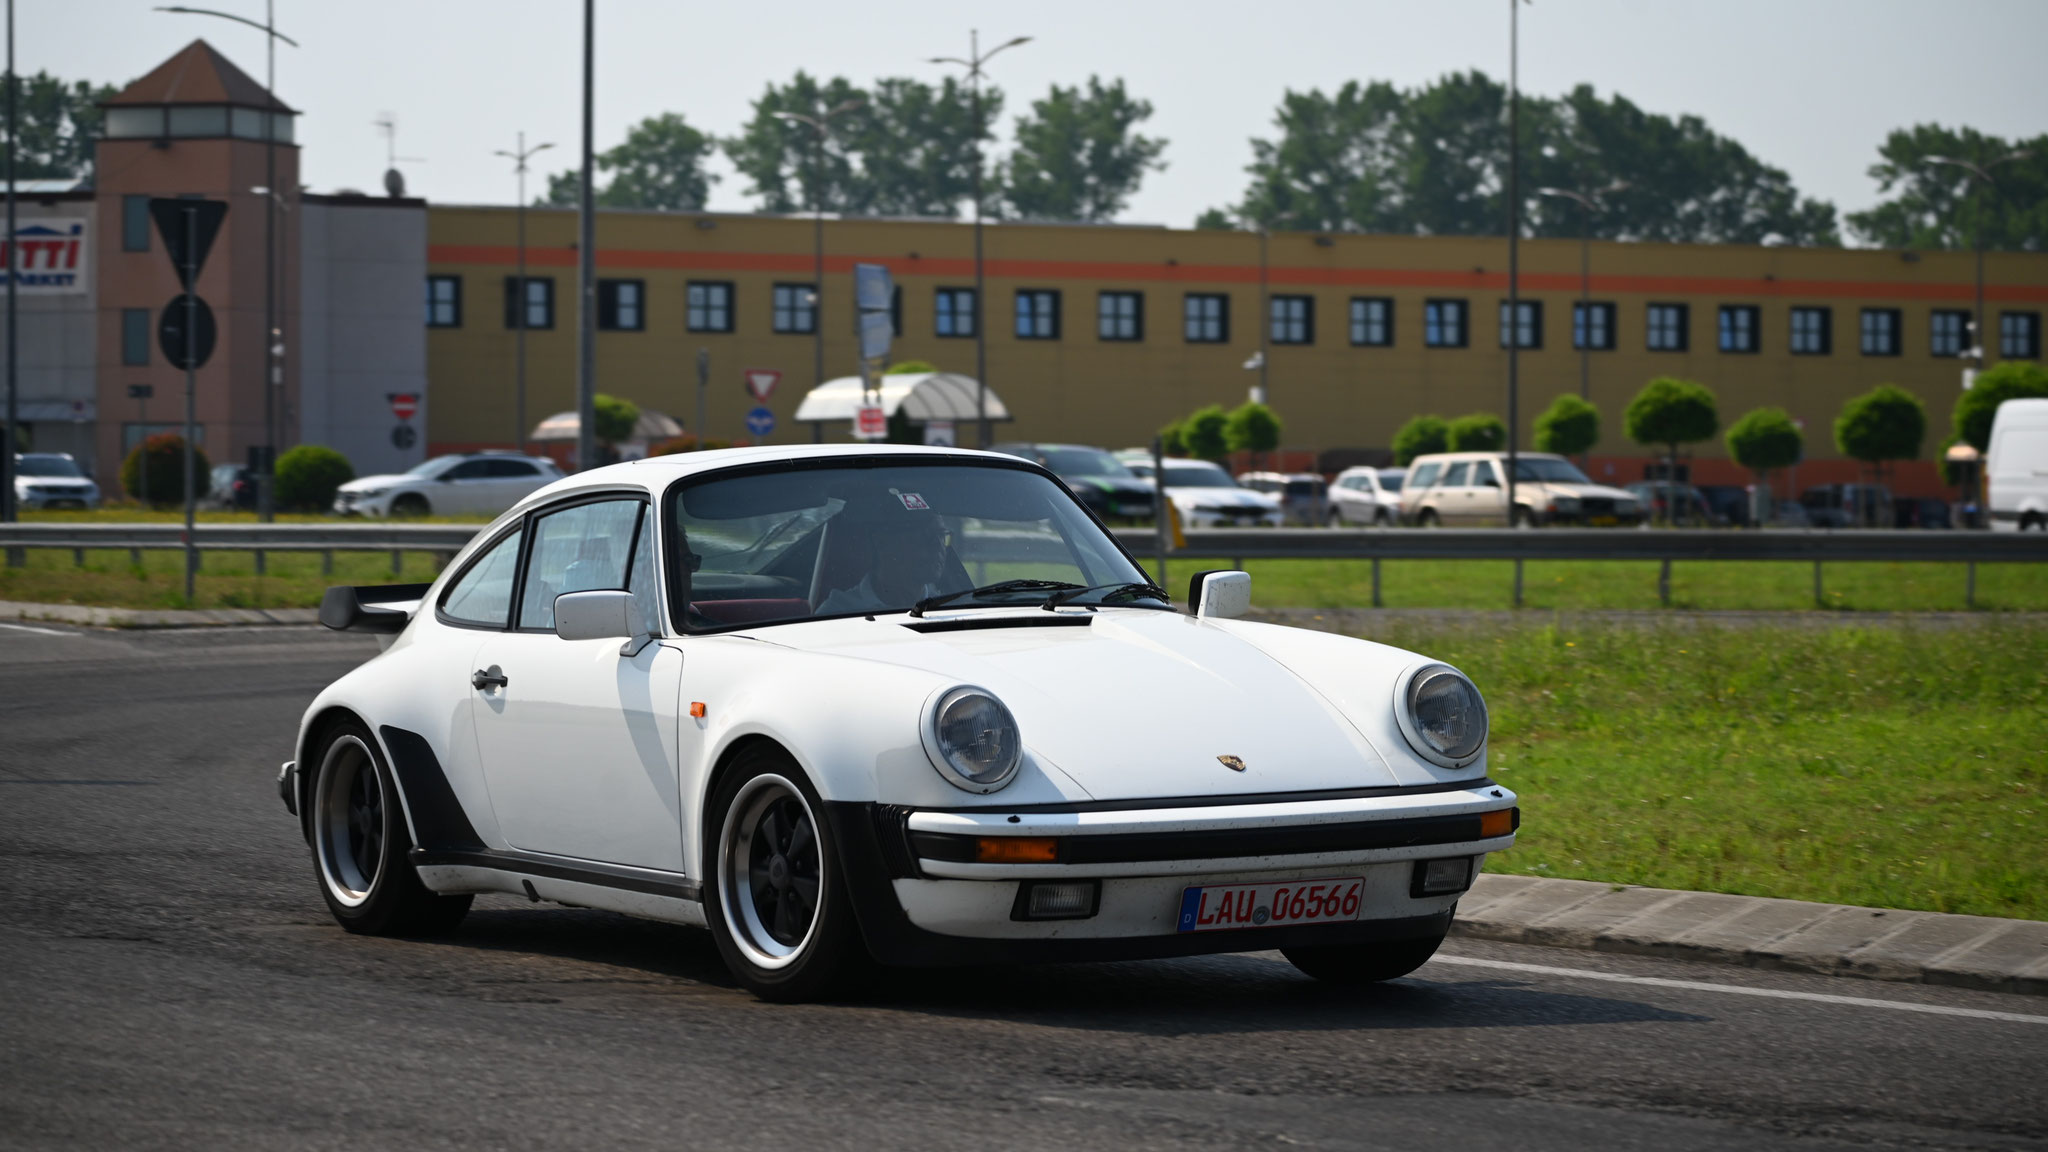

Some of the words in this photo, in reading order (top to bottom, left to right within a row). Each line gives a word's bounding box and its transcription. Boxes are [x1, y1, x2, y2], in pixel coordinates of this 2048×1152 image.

[1197, 889, 1256, 925] LAU
[1271, 883, 1360, 921] 06566
[1183, 913, 1192, 924] D
